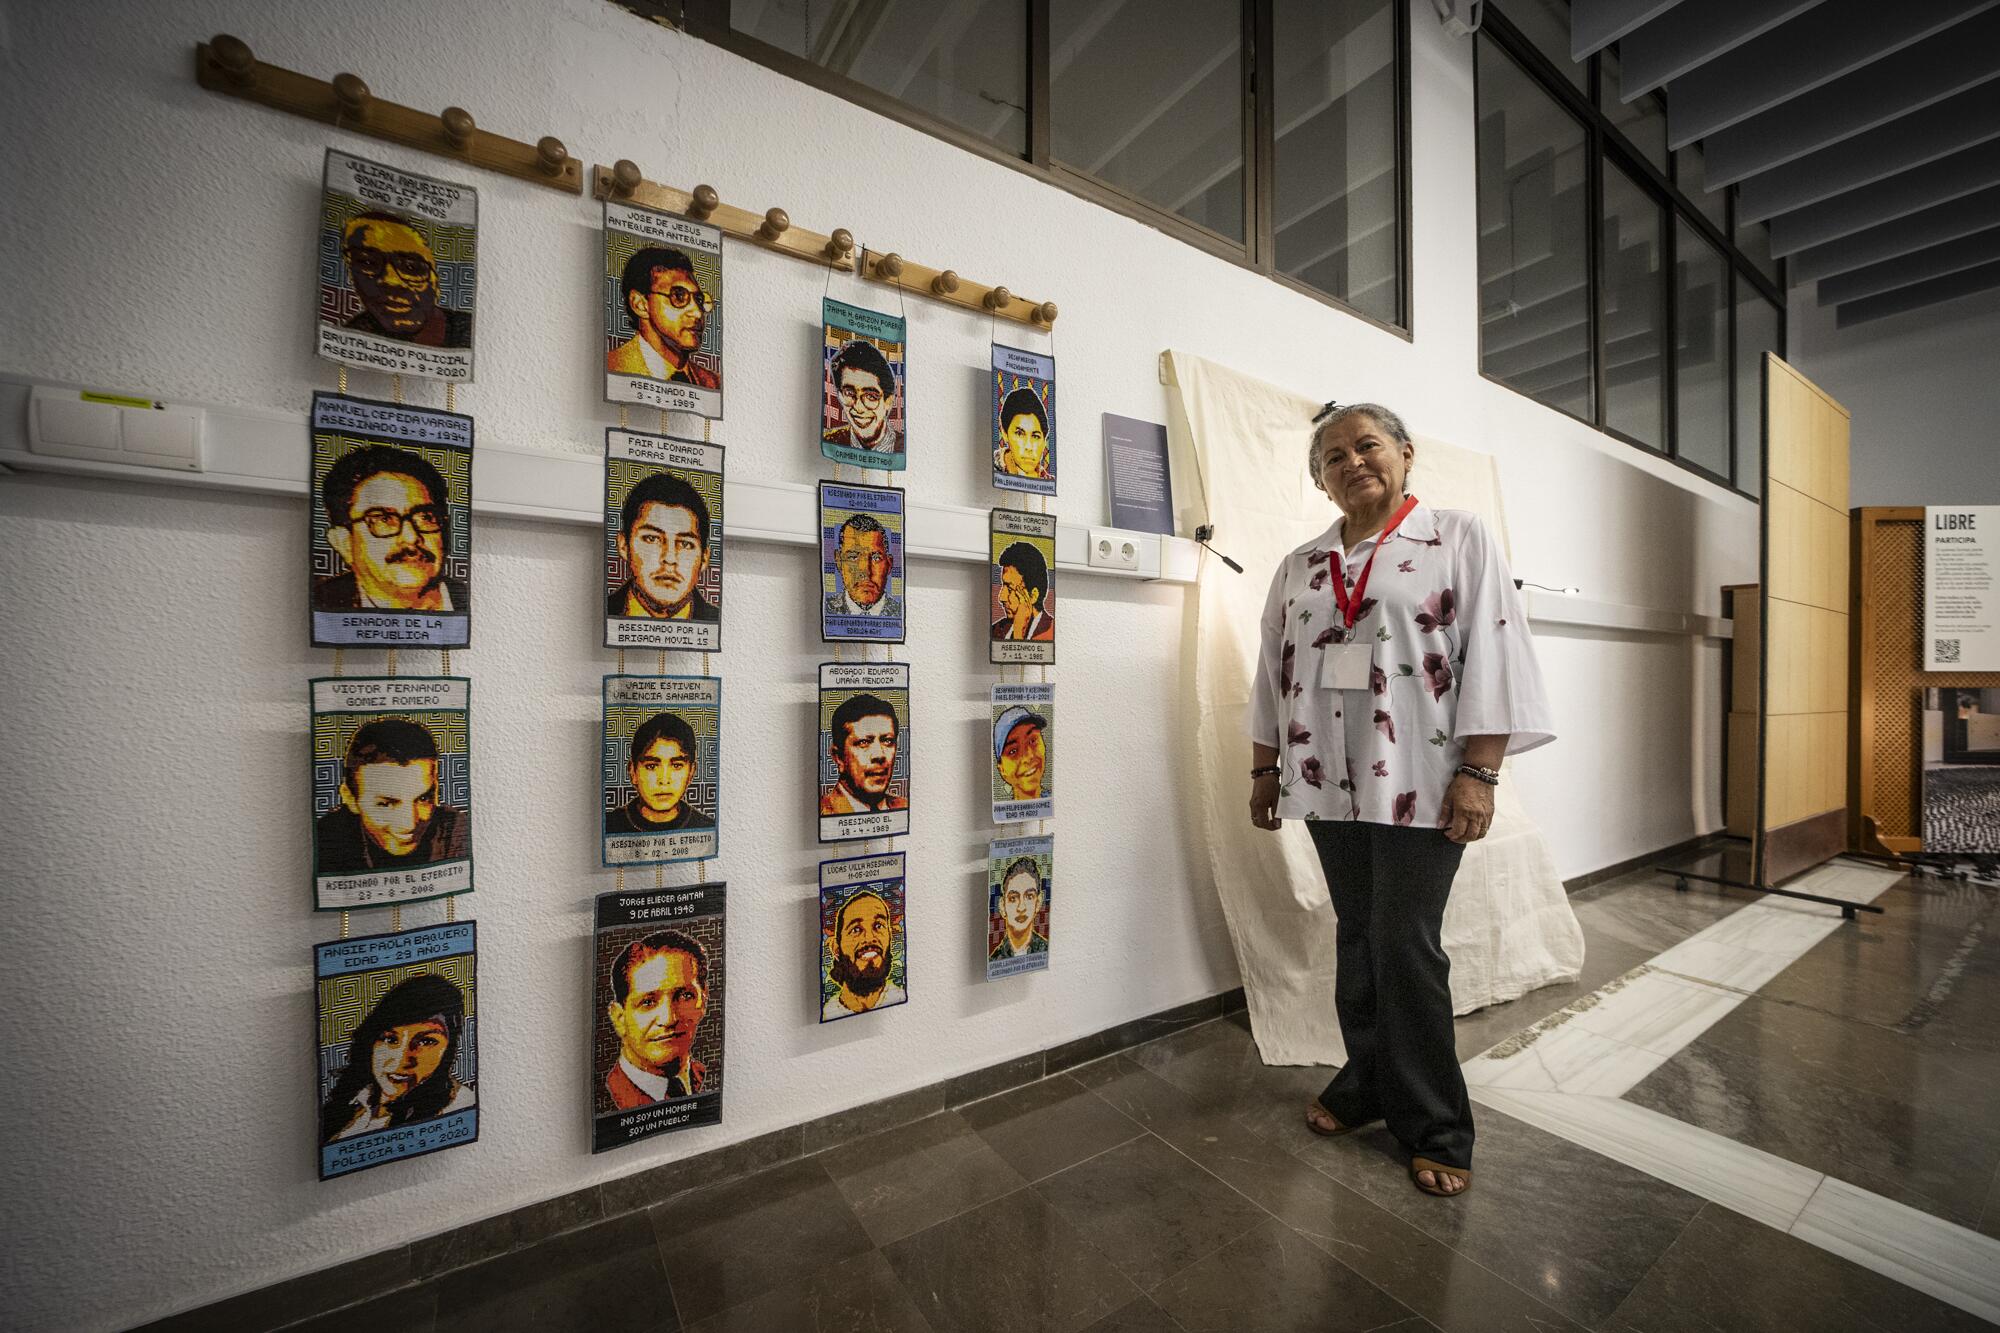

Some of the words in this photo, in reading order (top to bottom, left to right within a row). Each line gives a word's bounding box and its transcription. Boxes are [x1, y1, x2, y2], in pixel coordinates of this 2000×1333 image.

[359, 187, 391, 203] EDAD
[627, 212, 652, 224] JOSE
[656, 218, 668, 228] DE
[671, 223, 701, 236] JESUS
[826, 304, 847, 317] JAIME
[322, 330, 405, 357] BRUTALIDAD
[408, 352, 469, 366] POLICIAL
[323, 344, 397, 368] ASESINADO
[630, 380, 685, 397] ASESINADO
[689, 391, 700, 400] EL
[318, 401, 369, 418] MANUEL
[371, 410, 420, 424] CEPEDA
[422, 418, 468, 431] VARGAS
[320, 415, 397, 433] ASESINADO
[628, 437, 653, 448] FAIR
[657, 441, 704, 456] LEONARDO
[628, 448, 665, 460] PORRAS
[669, 453, 704, 467] BERNAL
[859, 455, 867, 463] DE
[1935, 514, 1976, 530] LIBRE
[1935, 536, 1977, 544] PARTICIPA
[342, 618, 400, 627] SENADOR
[405, 619, 423, 628] DE
[426, 620, 442, 629] LA
[618, 624, 673, 633] ASESINADO
[676, 626, 693, 634] POR
[697, 627, 709, 635] LA
[356, 630, 430, 640] REPUBLICA
[618, 634, 661, 643] BRIGADA
[665, 636, 693, 645] MOVIL
[697, 638, 708, 646] 15
[867, 667, 900, 675] EDUARDO
[332, 685, 382, 693] VICTOR
[386, 684, 450, 693] FERNANDO
[626, 682, 656, 690] JAIME
[660, 682, 701, 690] ESTIVEN
[346, 697, 387, 706] GOMEZ
[392, 696, 439, 705] ROMERO
[614, 692, 662, 700] VALENCIA
[665, 692, 712, 701] SANABRIA
[838, 816, 880, 827] ASESINADO
[611, 840, 650, 849] ASESINADO
[669, 837, 677, 845] EL
[680, 835, 712, 844] EJERCITO
[827, 865, 847, 875] LUCAS
[866, 859, 898, 869] ASESINADO
[326, 878, 378, 890] ASESINADO
[384, 876, 400, 885] POR
[405, 874, 416, 883] EL
[421, 866, 463, 881] EJERCITO
[619, 898, 645, 907] JORGE
[647, 894, 675, 905] ELIECER
[677, 891, 704, 902] GAITAN
[630, 911, 636, 919] 9
[637, 909, 649, 918] DE
[651, 907, 672, 917] ABRIL
[673, 904, 695, 915] 1948
[324, 944, 367, 958] ANGIE
[369, 938, 411, 951] PAOLA
[344, 955, 379, 967] EDAD
[396, 949, 412, 960] 29
[417, 943, 449, 957] AÑOS
[636, 1111, 652, 1122] SOY
[653, 1108, 665, 1118] UN
[665, 1102, 697, 1115] HOMBRE
[338, 1130, 414, 1155] ASESINADA
[419, 1123, 443, 1136] POR
[448, 1117, 463, 1128] LA
[628, 1125, 645, 1137] SOY
[645, 1121, 657, 1131] UN
[332, 1146, 393, 1169] POLICIA
